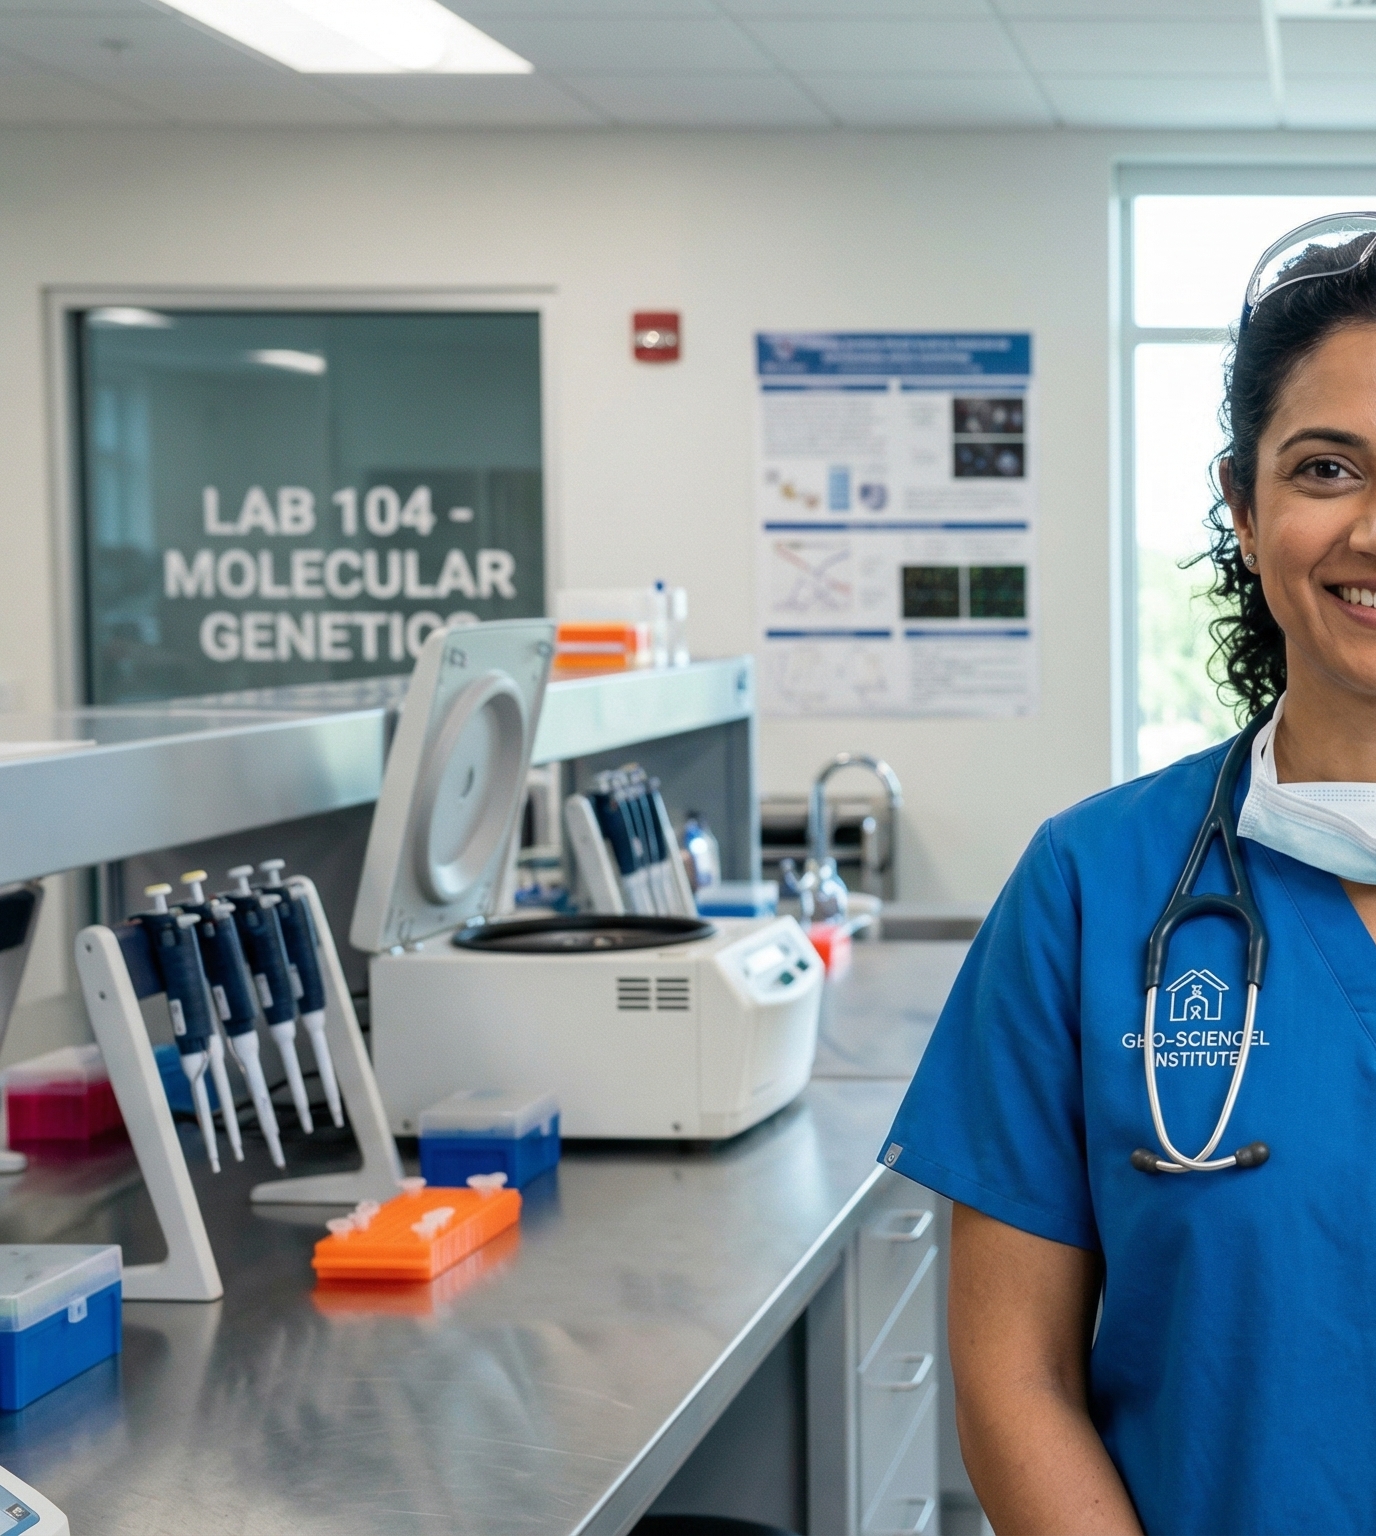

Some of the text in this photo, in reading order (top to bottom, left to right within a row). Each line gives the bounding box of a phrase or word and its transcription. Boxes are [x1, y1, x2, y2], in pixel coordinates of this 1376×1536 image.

[202, 486, 474, 536] LAB 104 -
[164, 548, 515, 599] MOLECULAR
[200, 611, 480, 662] GENETIC
[1155, 1051, 1239, 1068] NSTITUTE
